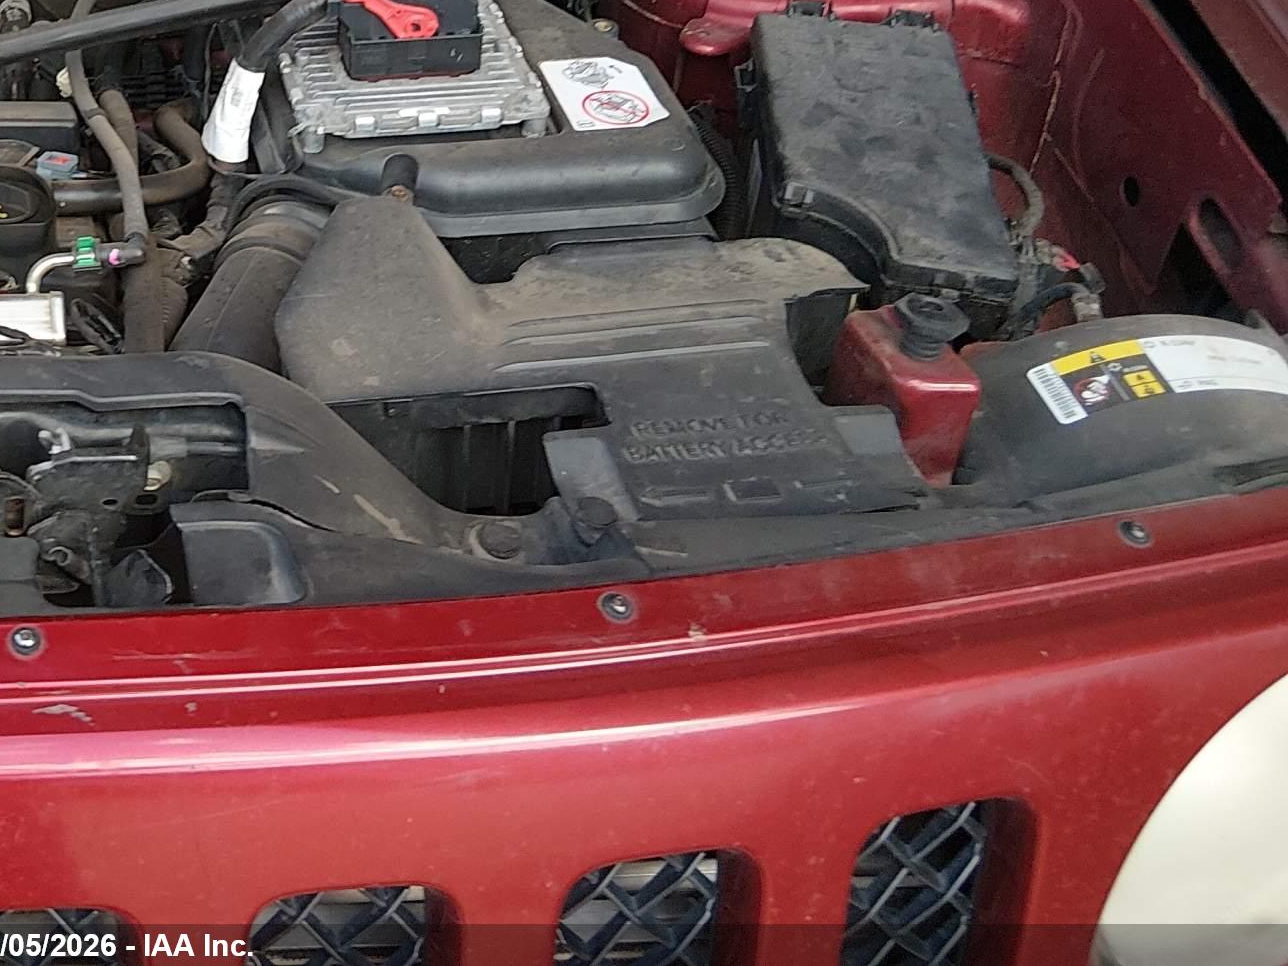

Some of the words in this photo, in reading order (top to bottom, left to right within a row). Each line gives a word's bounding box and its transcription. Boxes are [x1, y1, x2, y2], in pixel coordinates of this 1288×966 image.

[630, 416, 733, 438] REMOVE
[736, 410, 790, 430] FOR
[622, 439, 727, 464] BATTERY
[730, 427, 830, 456] ACCESS
